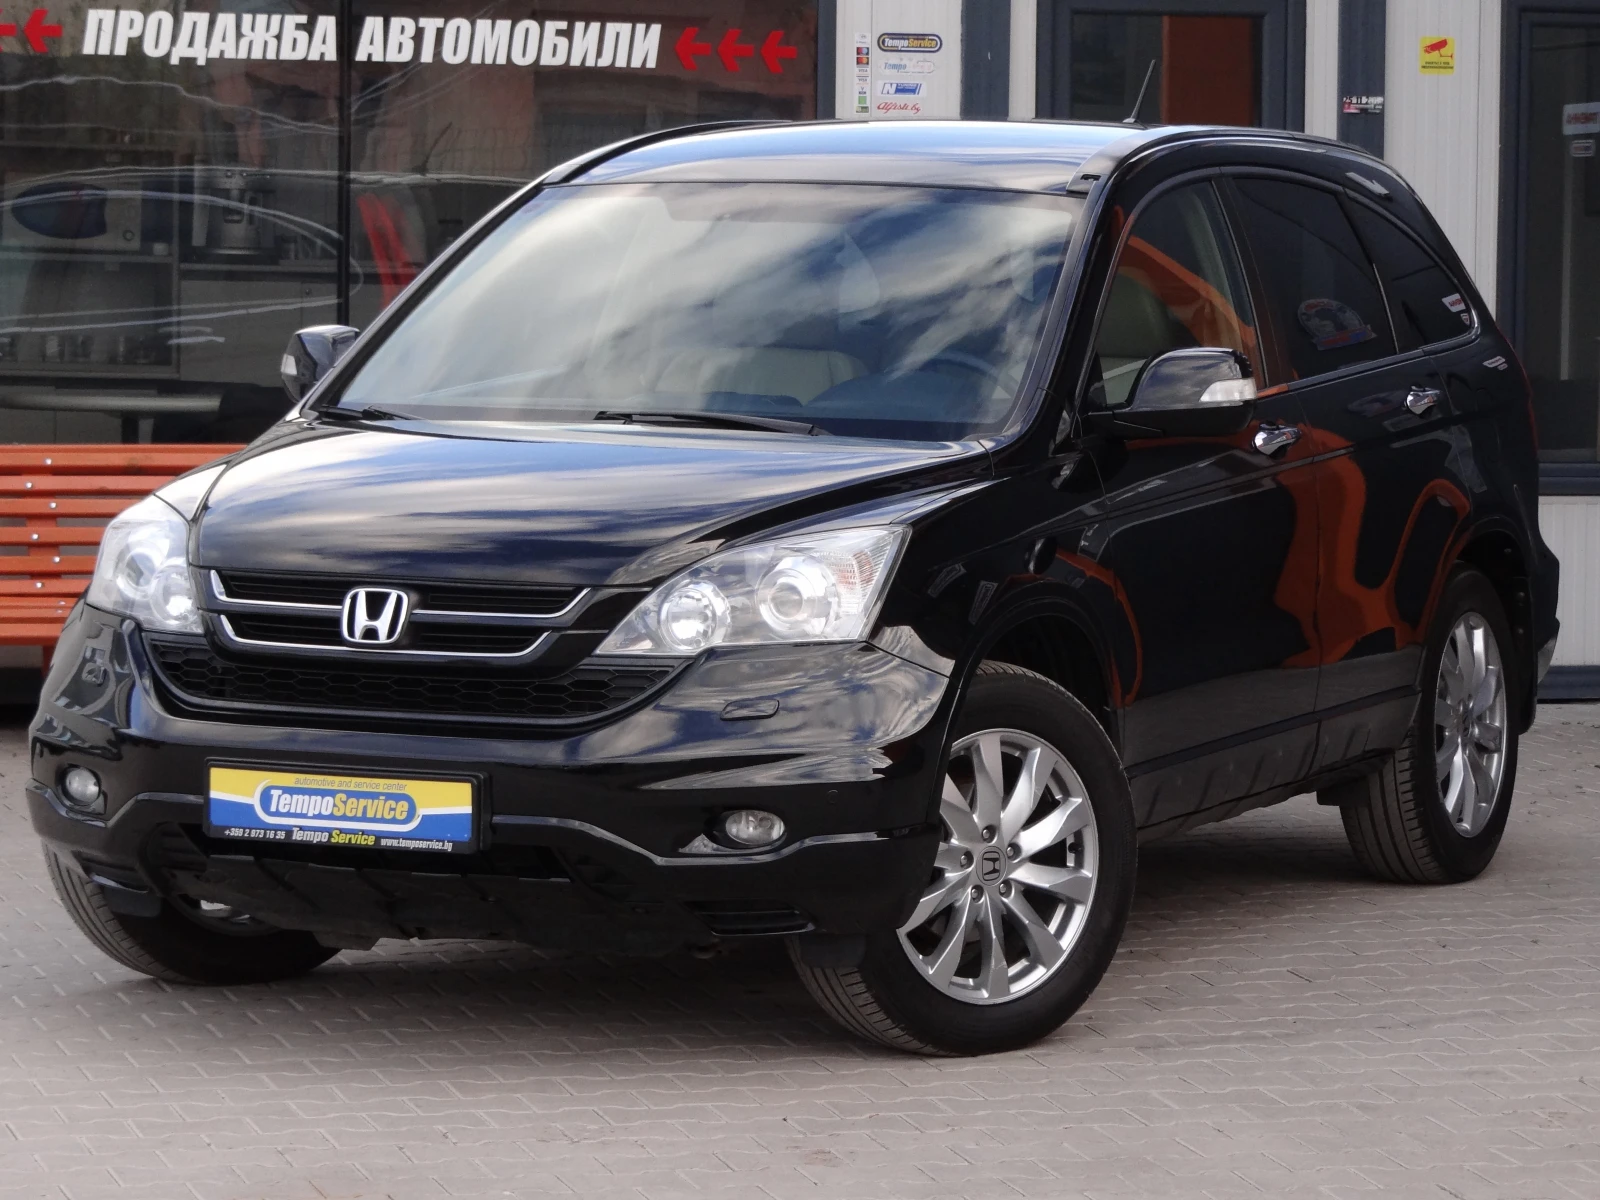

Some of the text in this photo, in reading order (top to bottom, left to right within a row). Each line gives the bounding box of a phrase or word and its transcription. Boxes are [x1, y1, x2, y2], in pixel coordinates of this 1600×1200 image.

[82, 9, 662, 70] ПРОДАЖБА АВТОМОБИЛИ
[884, 38, 937, 50] TempoService
[294, 776, 407, 791] automotive and service center
[269, 789, 409, 820] TempoService
[224, 827, 243, 837] +359
[244, 829, 250, 837] 2
[275, 830, 286, 839] 35
[292, 827, 329, 843] Tempo
[330, 829, 376, 846] Service
[380, 838, 453, 851] www.temposervice.bg
